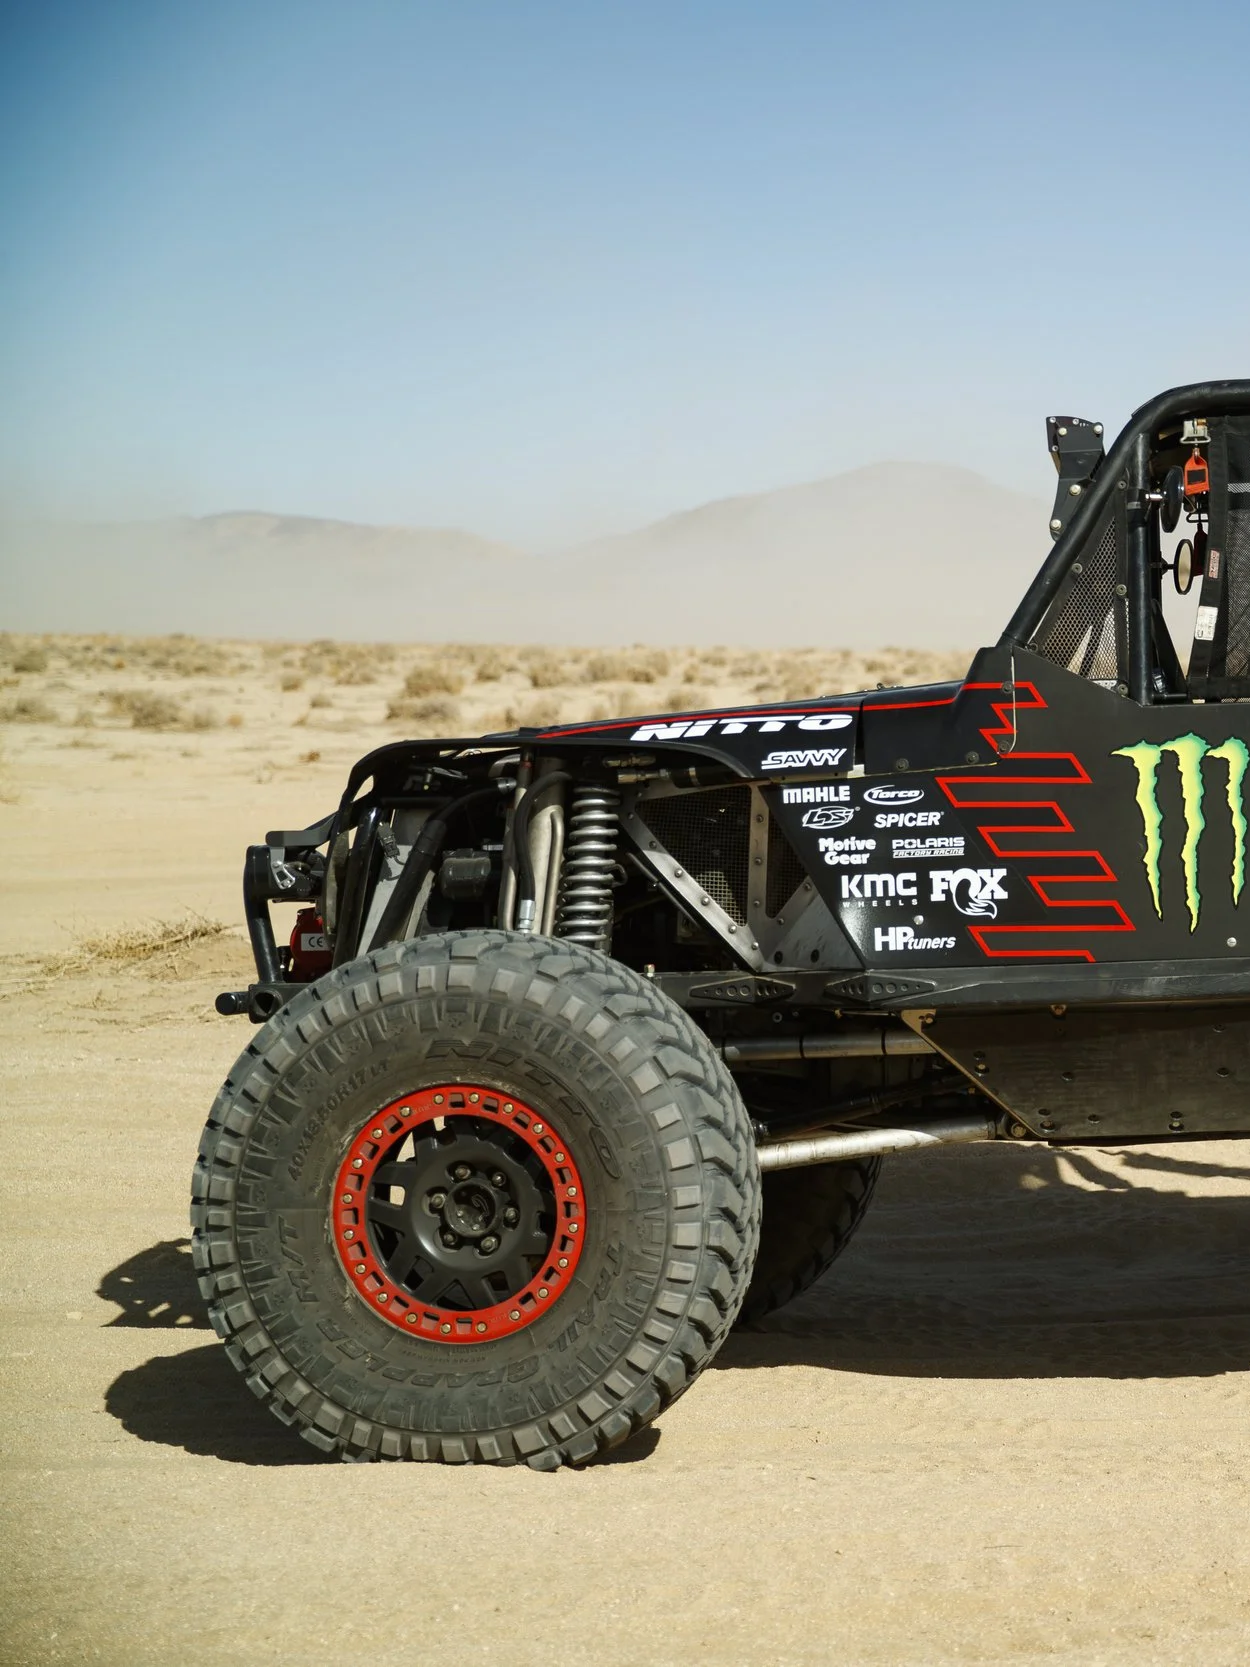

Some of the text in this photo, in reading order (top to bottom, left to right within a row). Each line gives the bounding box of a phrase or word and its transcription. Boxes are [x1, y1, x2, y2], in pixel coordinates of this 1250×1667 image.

[630, 714, 853, 741] NITTO
[761, 749, 847, 770] SAVVY
[783, 785, 850, 804] MAHLE
[874, 812, 940, 828] SPICER
[819, 836, 876, 853] Motive
[892, 836, 965, 849] POLARIS
[824, 851, 870, 865] Gear
[930, 867, 1008, 915] FOX
[842, 899, 918, 907] WHEELS
[425, 1039, 623, 1180] NITTO
